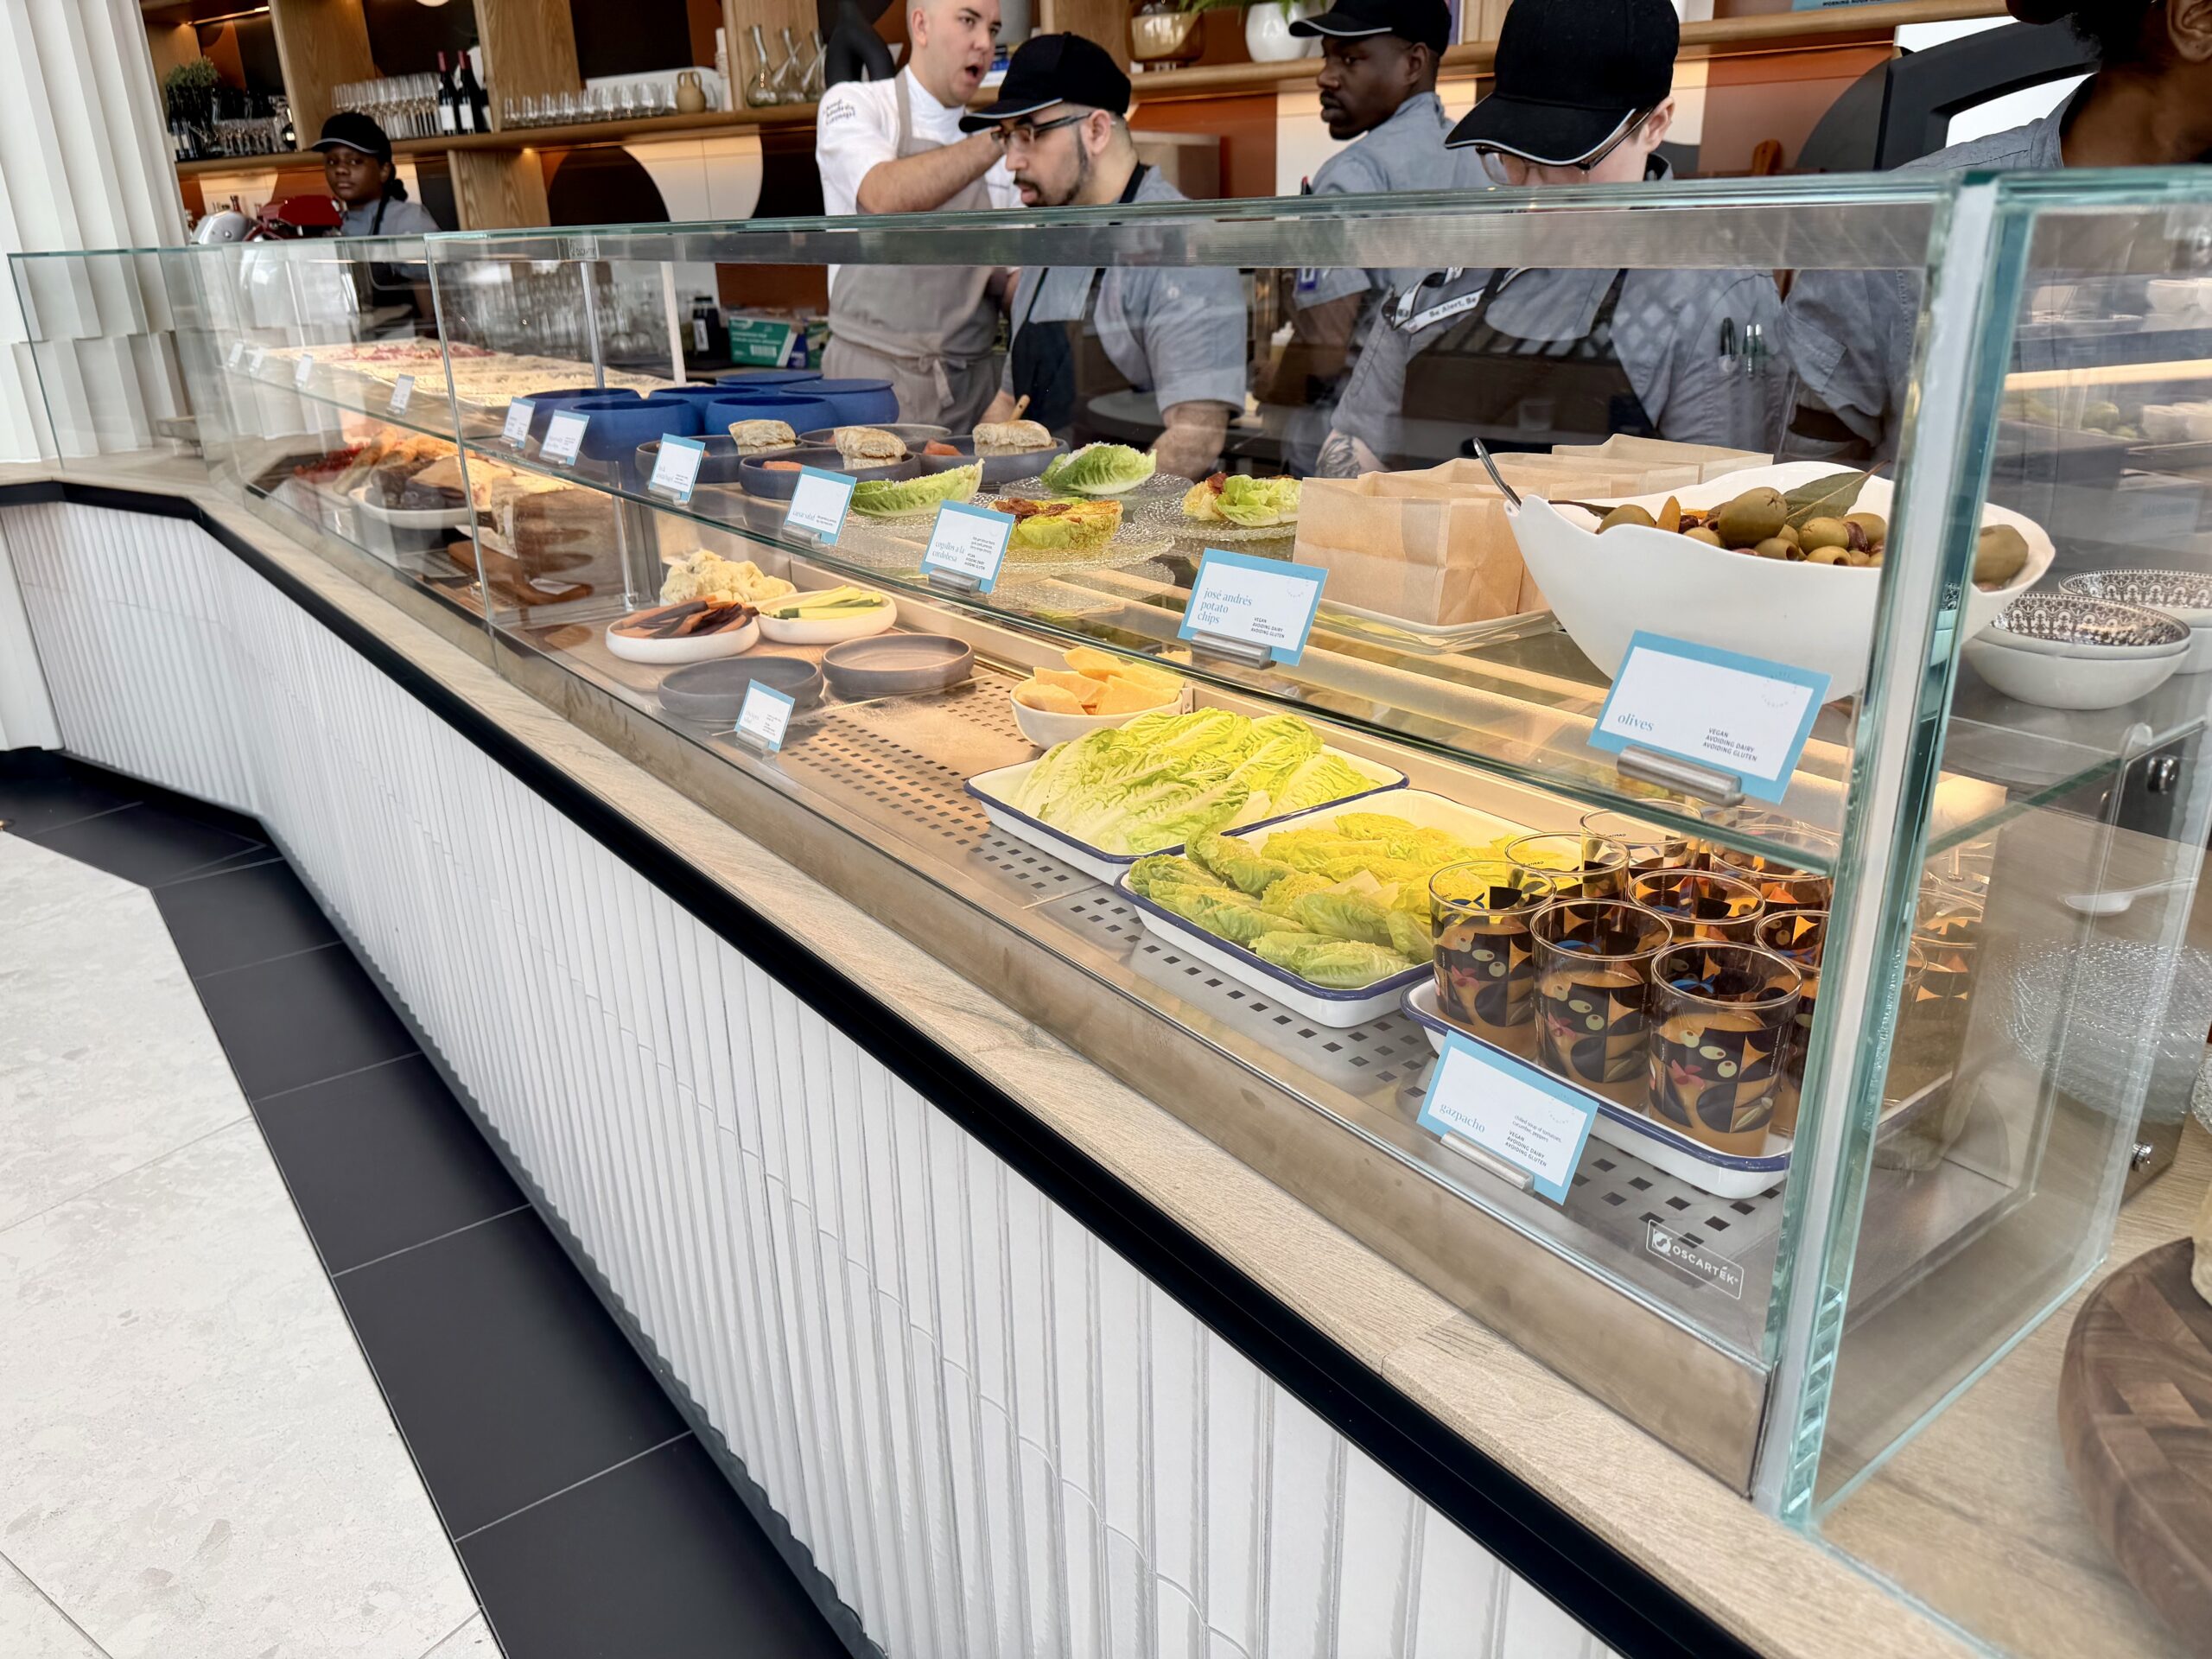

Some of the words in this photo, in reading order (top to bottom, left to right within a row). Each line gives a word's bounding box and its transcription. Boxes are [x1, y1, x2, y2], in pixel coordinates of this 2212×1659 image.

[1199, 600, 1229, 613] potato
[1203, 588, 1223, 601] josé
[1222, 590, 1253, 607] andrés
[1197, 611, 1221, 625] chips
[1252, 622, 1271, 631] AVOIDING
[1250, 627, 1269, 636] AVOIDING
[1617, 713, 1655, 733] olives
[1708, 727, 1729, 739] VEGAN
[1702, 741, 1732, 756] AVOIDING
[1732, 749, 1758, 762] GLUTEN
[1705, 734, 1735, 748] AVOIDING
[1735, 742, 1755, 753] DAIRY
[1439, 1103, 1486, 1134] gazpacho
[1509, 1129, 1525, 1141] VEGAN
[1504, 1141, 1528, 1157] AVOIDING
[1528, 1154, 1548, 1167] GLUTEN
[1506, 1135, 1529, 1151] AVOIDING
[1529, 1147, 1545, 1159] DAIRY
